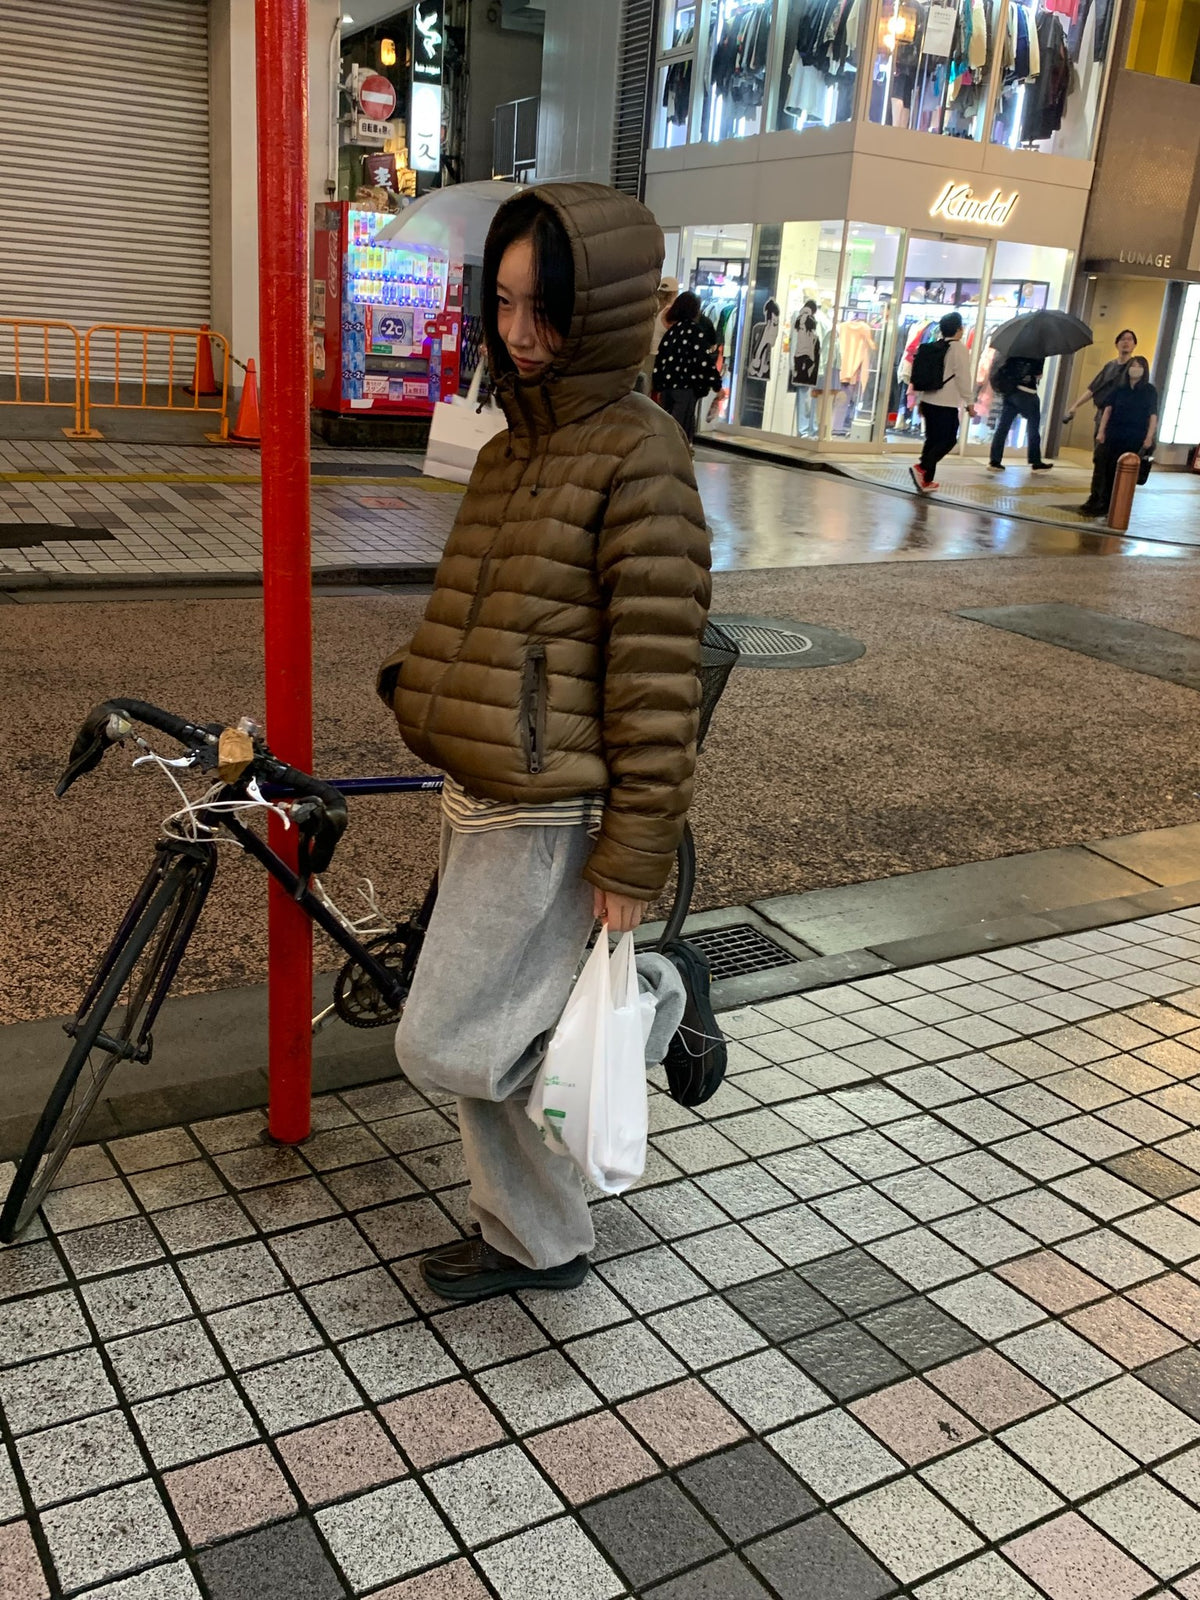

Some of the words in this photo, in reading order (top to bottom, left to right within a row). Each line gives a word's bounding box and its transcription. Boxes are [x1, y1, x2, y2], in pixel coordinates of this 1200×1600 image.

[361, 122, 391, 136] 自転車を除く
[932, 183, 1019, 225] Kindal
[1119, 249, 1172, 269] LUNAGE
